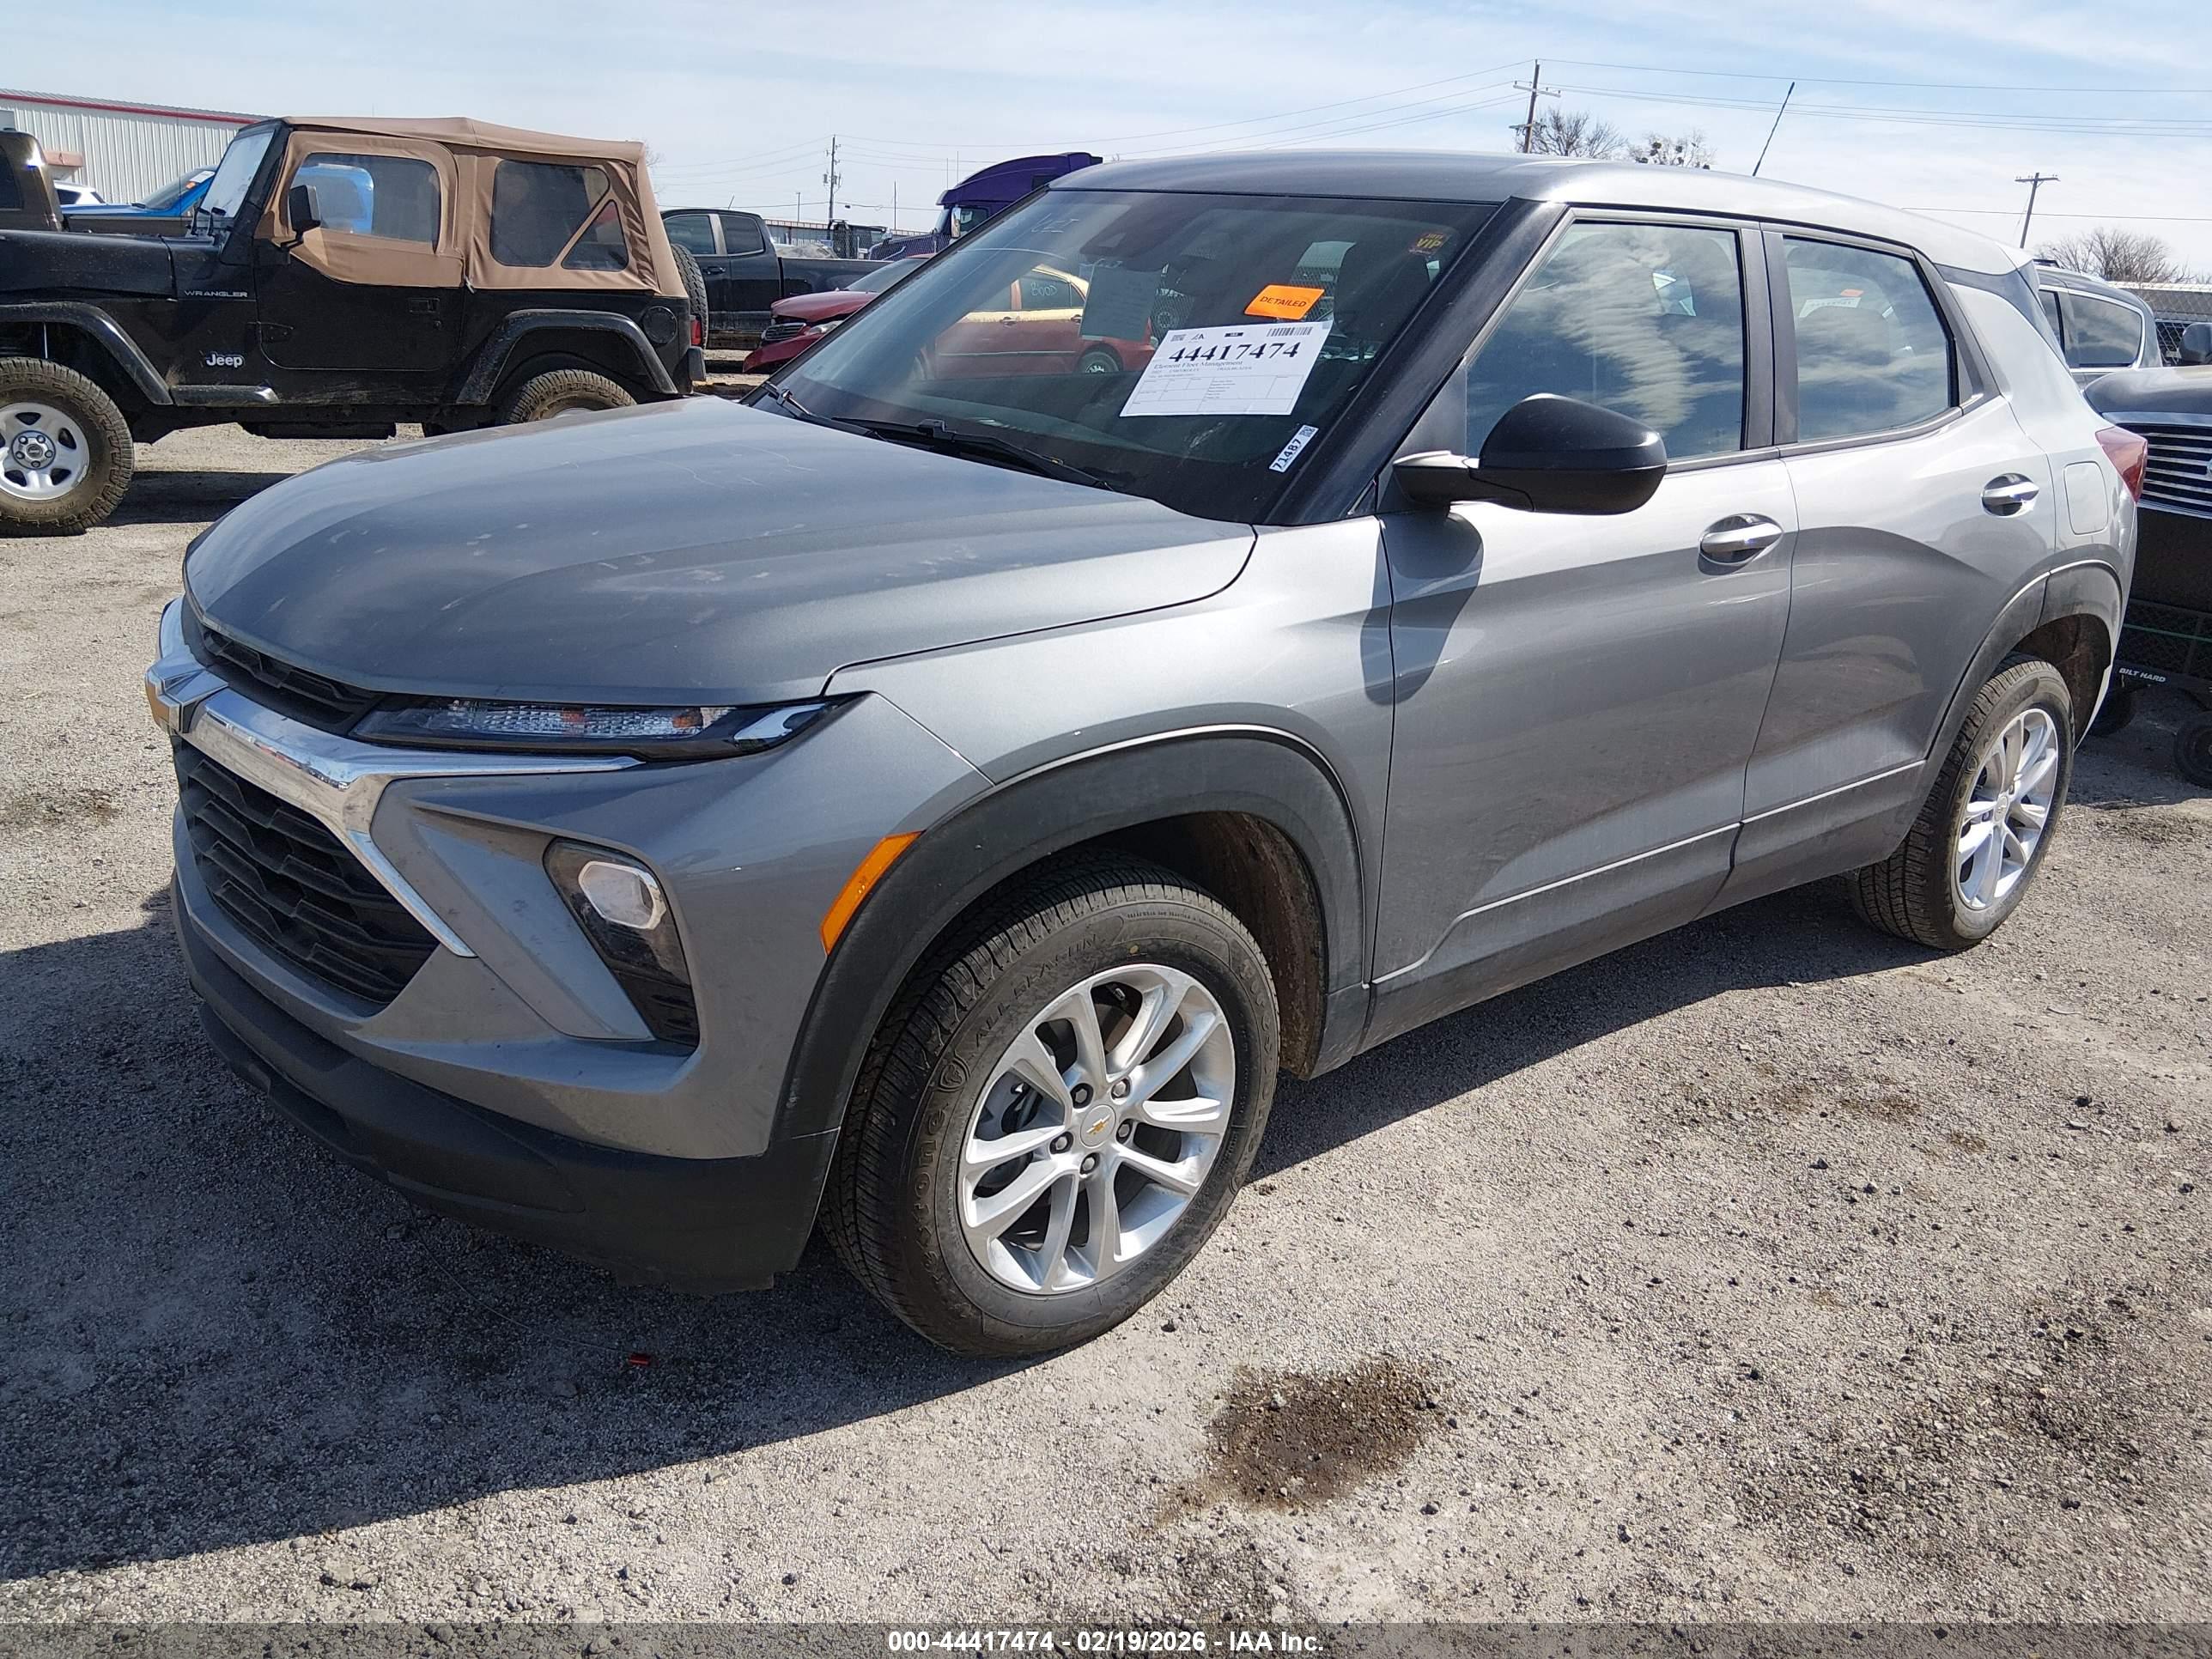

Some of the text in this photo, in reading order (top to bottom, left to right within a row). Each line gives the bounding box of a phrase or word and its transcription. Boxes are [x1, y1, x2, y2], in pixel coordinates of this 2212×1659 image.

[1417, 239, 1441, 249] VIP
[1260, 296, 1307, 307] DETAILED
[1169, 342, 1301, 362] 44417474
[206, 354, 243, 368] Jeep
[1272, 438, 1302, 471] 71487
[2118, 667, 2166, 683] BILT HARD
